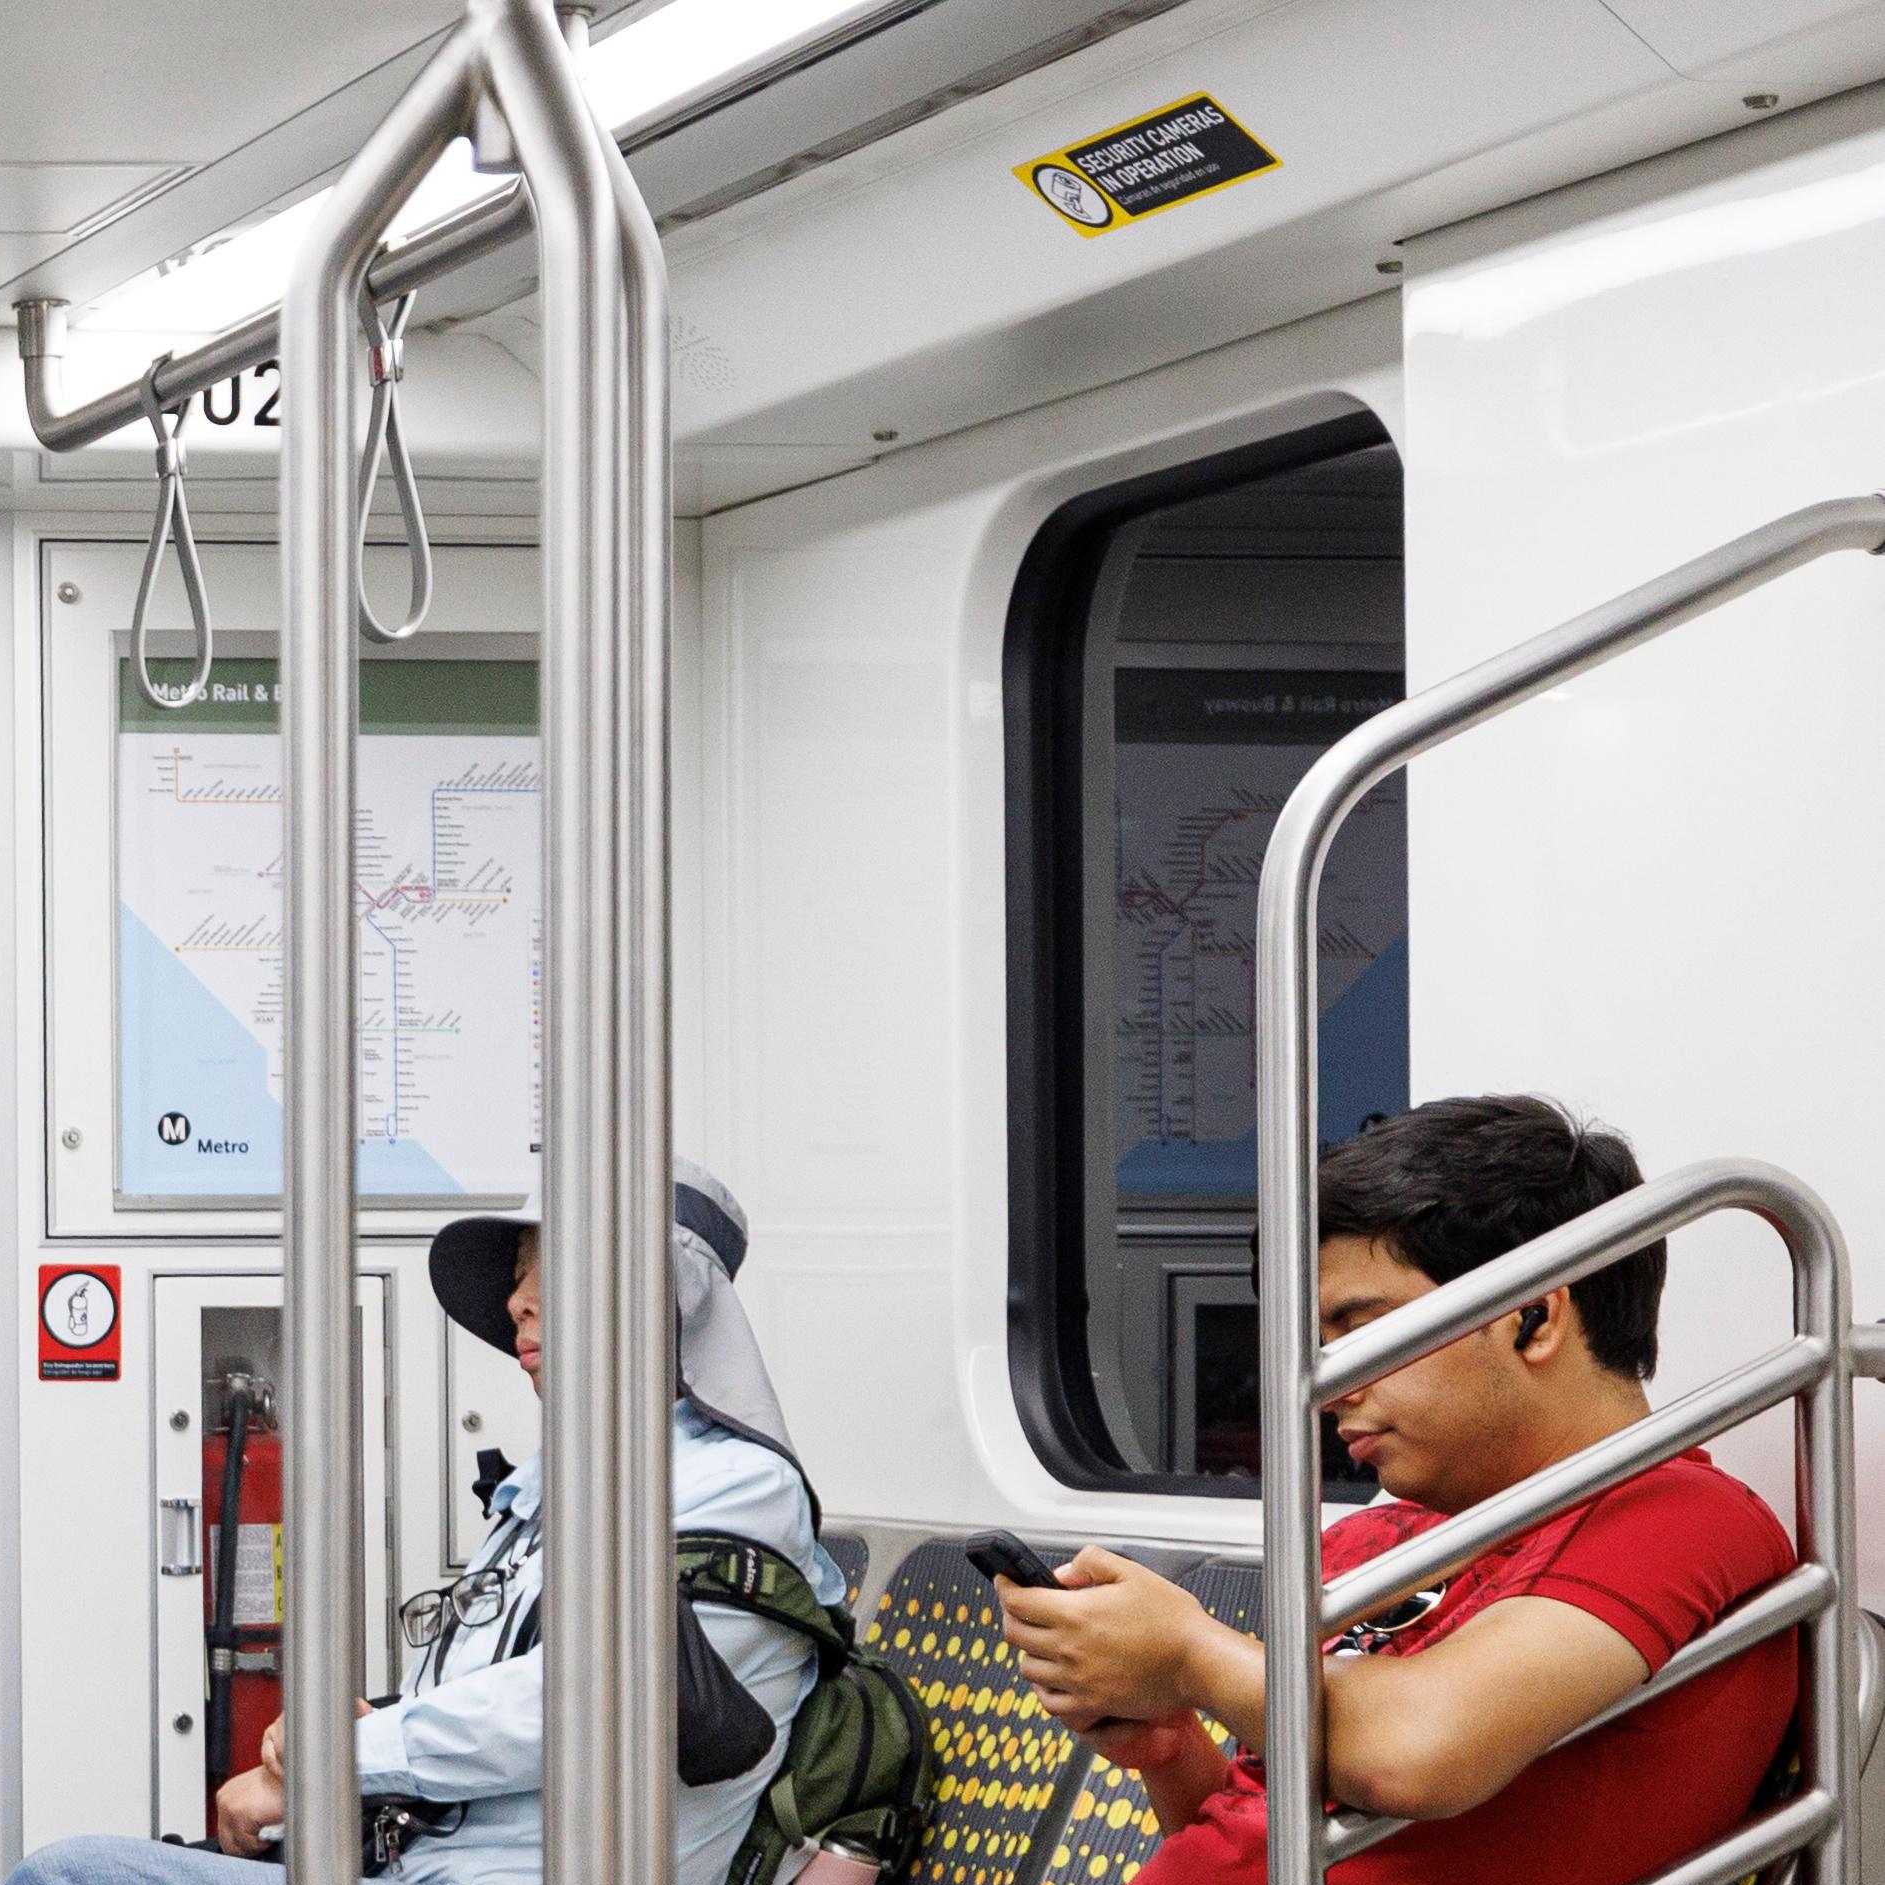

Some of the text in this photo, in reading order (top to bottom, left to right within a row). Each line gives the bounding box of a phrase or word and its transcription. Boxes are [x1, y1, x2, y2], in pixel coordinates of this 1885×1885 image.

[1077, 106, 1225, 175] SECURITY CAMERAS
[1096, 142, 1205, 193] IN OPERATION
[212, 682, 249, 701] Rail
[254, 683, 269, 701] &
[197, 1138, 249, 1153] Metro
